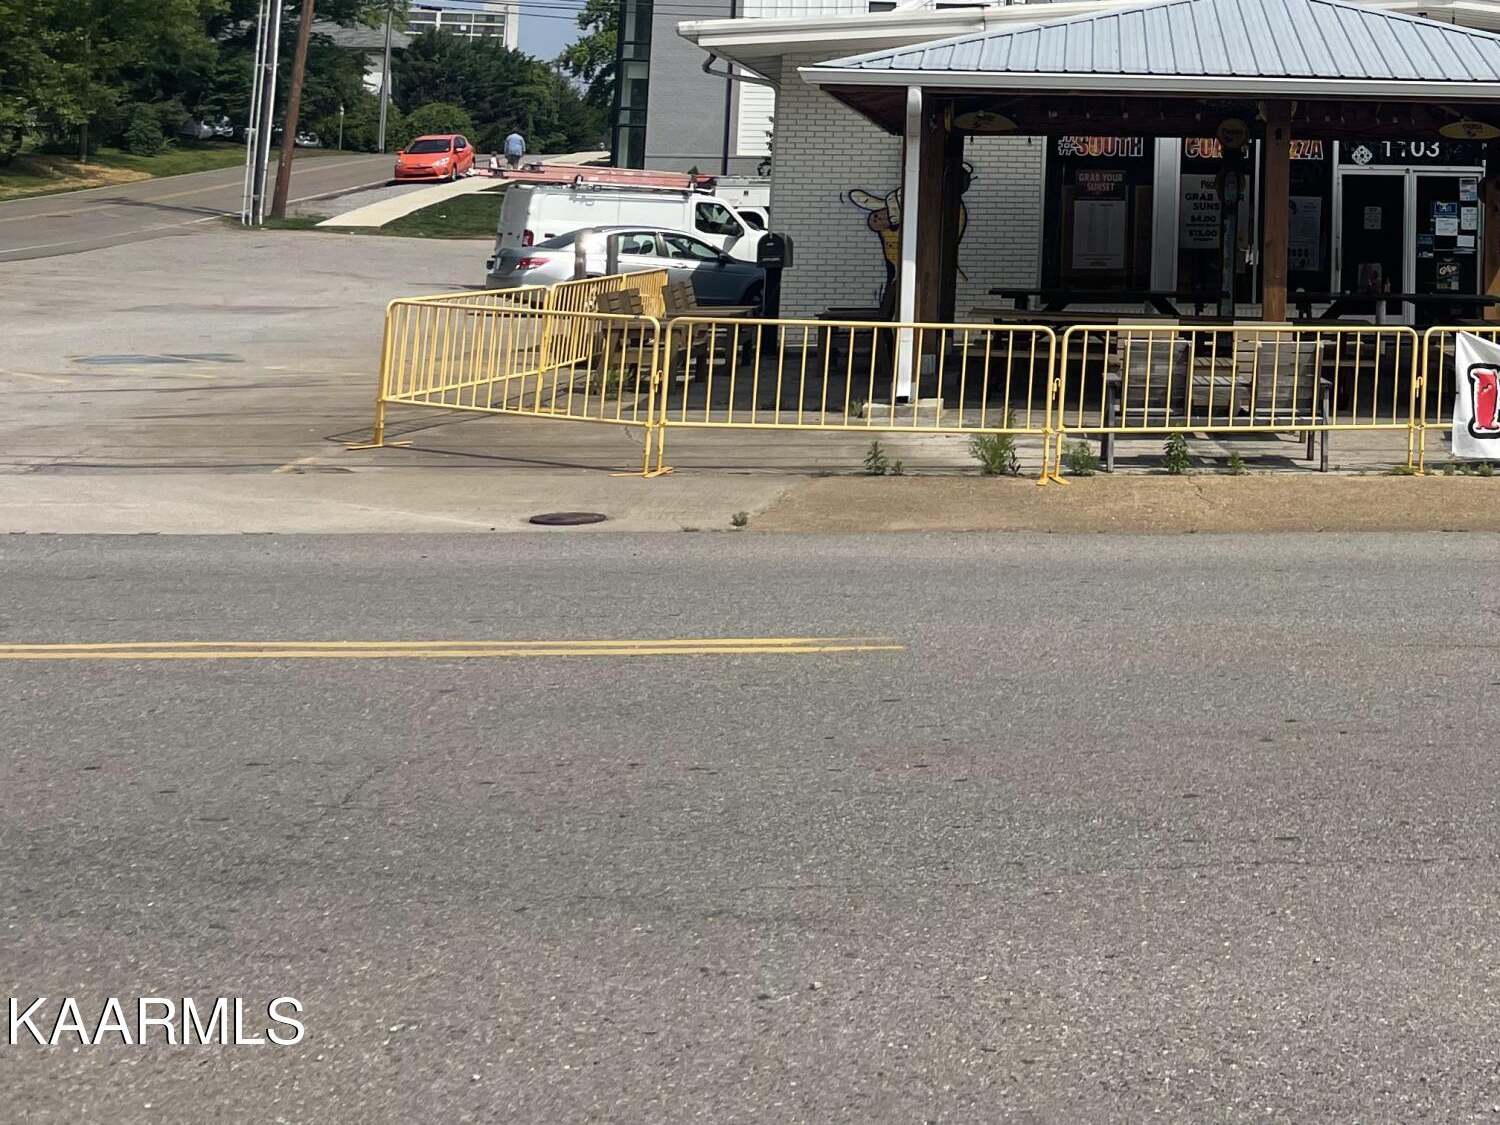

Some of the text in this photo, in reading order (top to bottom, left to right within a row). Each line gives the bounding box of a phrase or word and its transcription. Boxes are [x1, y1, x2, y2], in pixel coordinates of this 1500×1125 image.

[1058, 136, 1144, 158] #SOUTH
[1289, 139, 1324, 161] ZZA
[1079, 172, 1124, 183] GRAB YOUR
[1086, 182, 1116, 192] SUNSET
[1185, 193, 1214, 202] GRAB
[1193, 202, 1221, 211] SUNS
